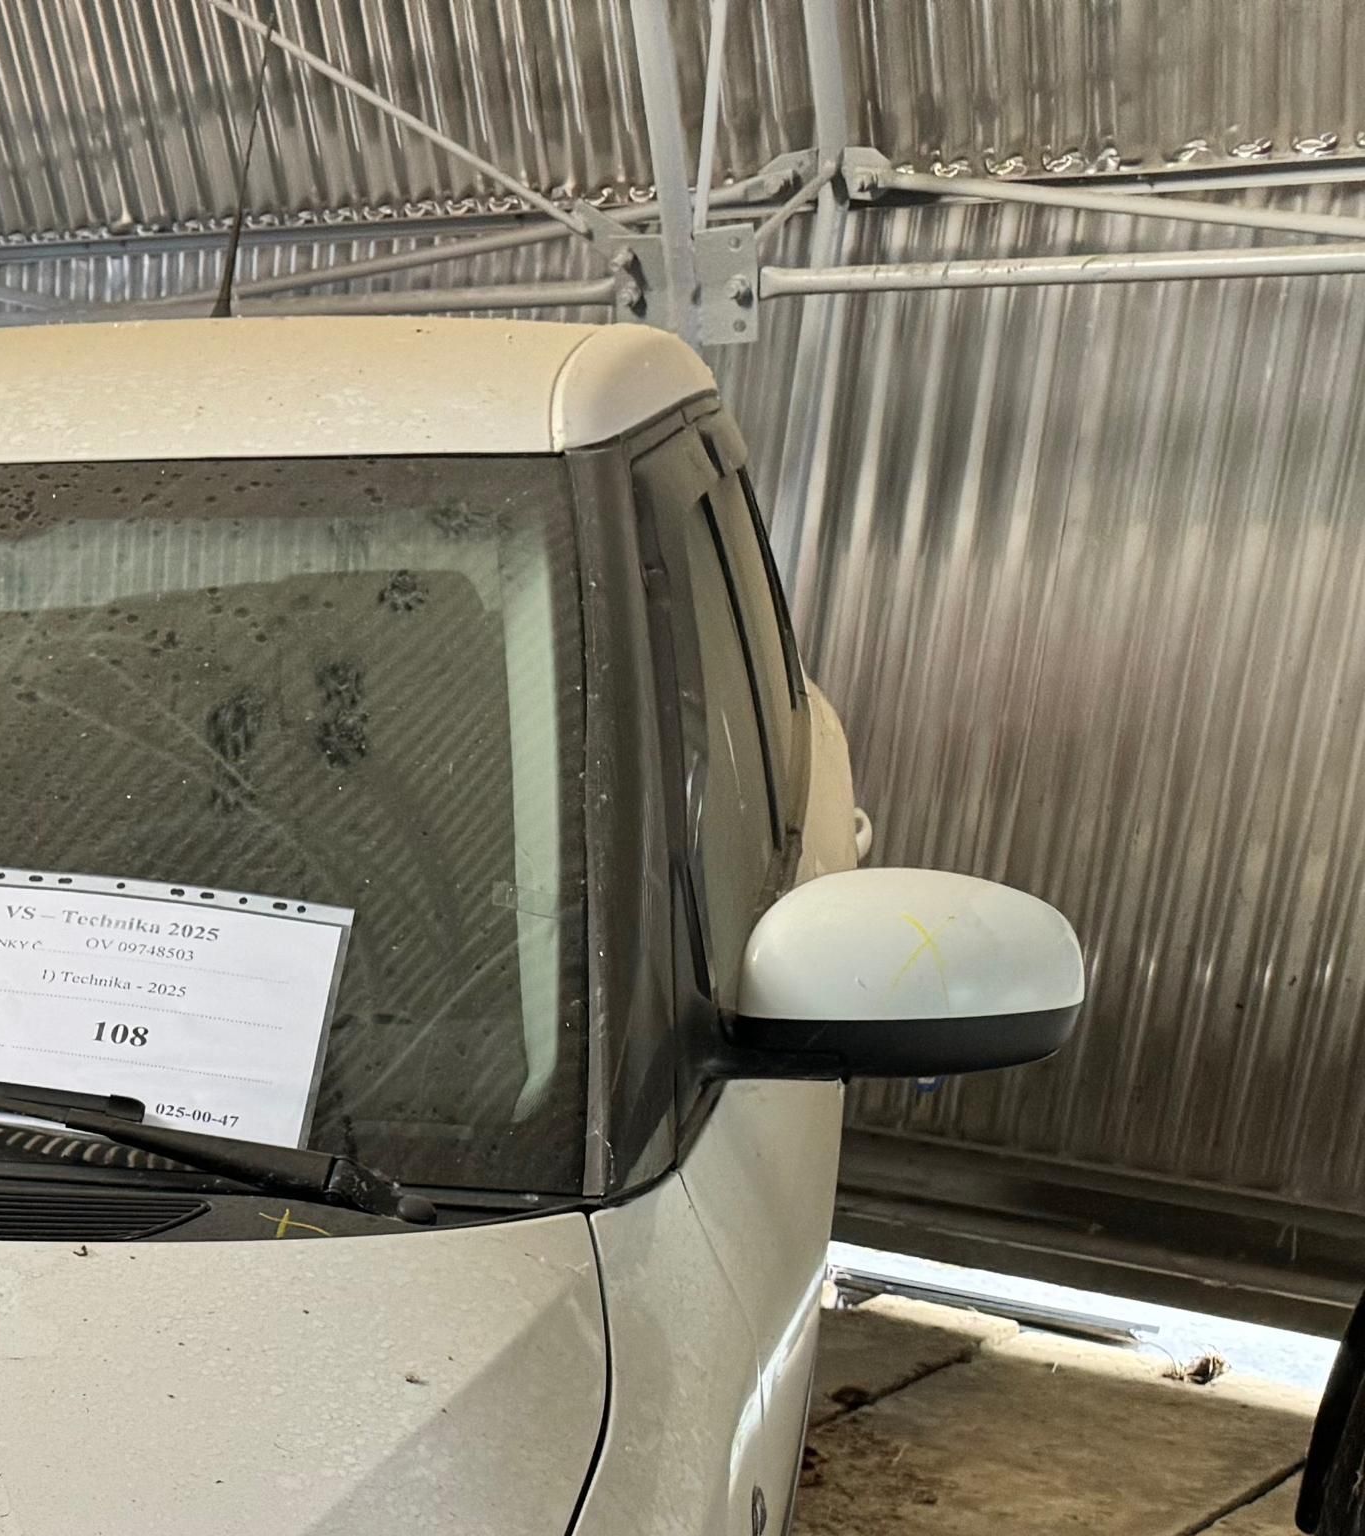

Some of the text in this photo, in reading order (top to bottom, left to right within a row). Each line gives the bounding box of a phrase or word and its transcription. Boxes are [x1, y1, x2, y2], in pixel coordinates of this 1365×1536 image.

[6, 904, 37, 922] VS
[62, 909, 161, 934] Technika
[168, 922, 220, 942] 2025
[85, 936, 114, 952] OV
[118, 941, 194, 962] 09748503
[61, 970, 131, 991] Technika
[148, 982, 187, 999] 2025
[93, 1021, 149, 1047] 108
[155, 1103, 239, 1128] 025-00-47
